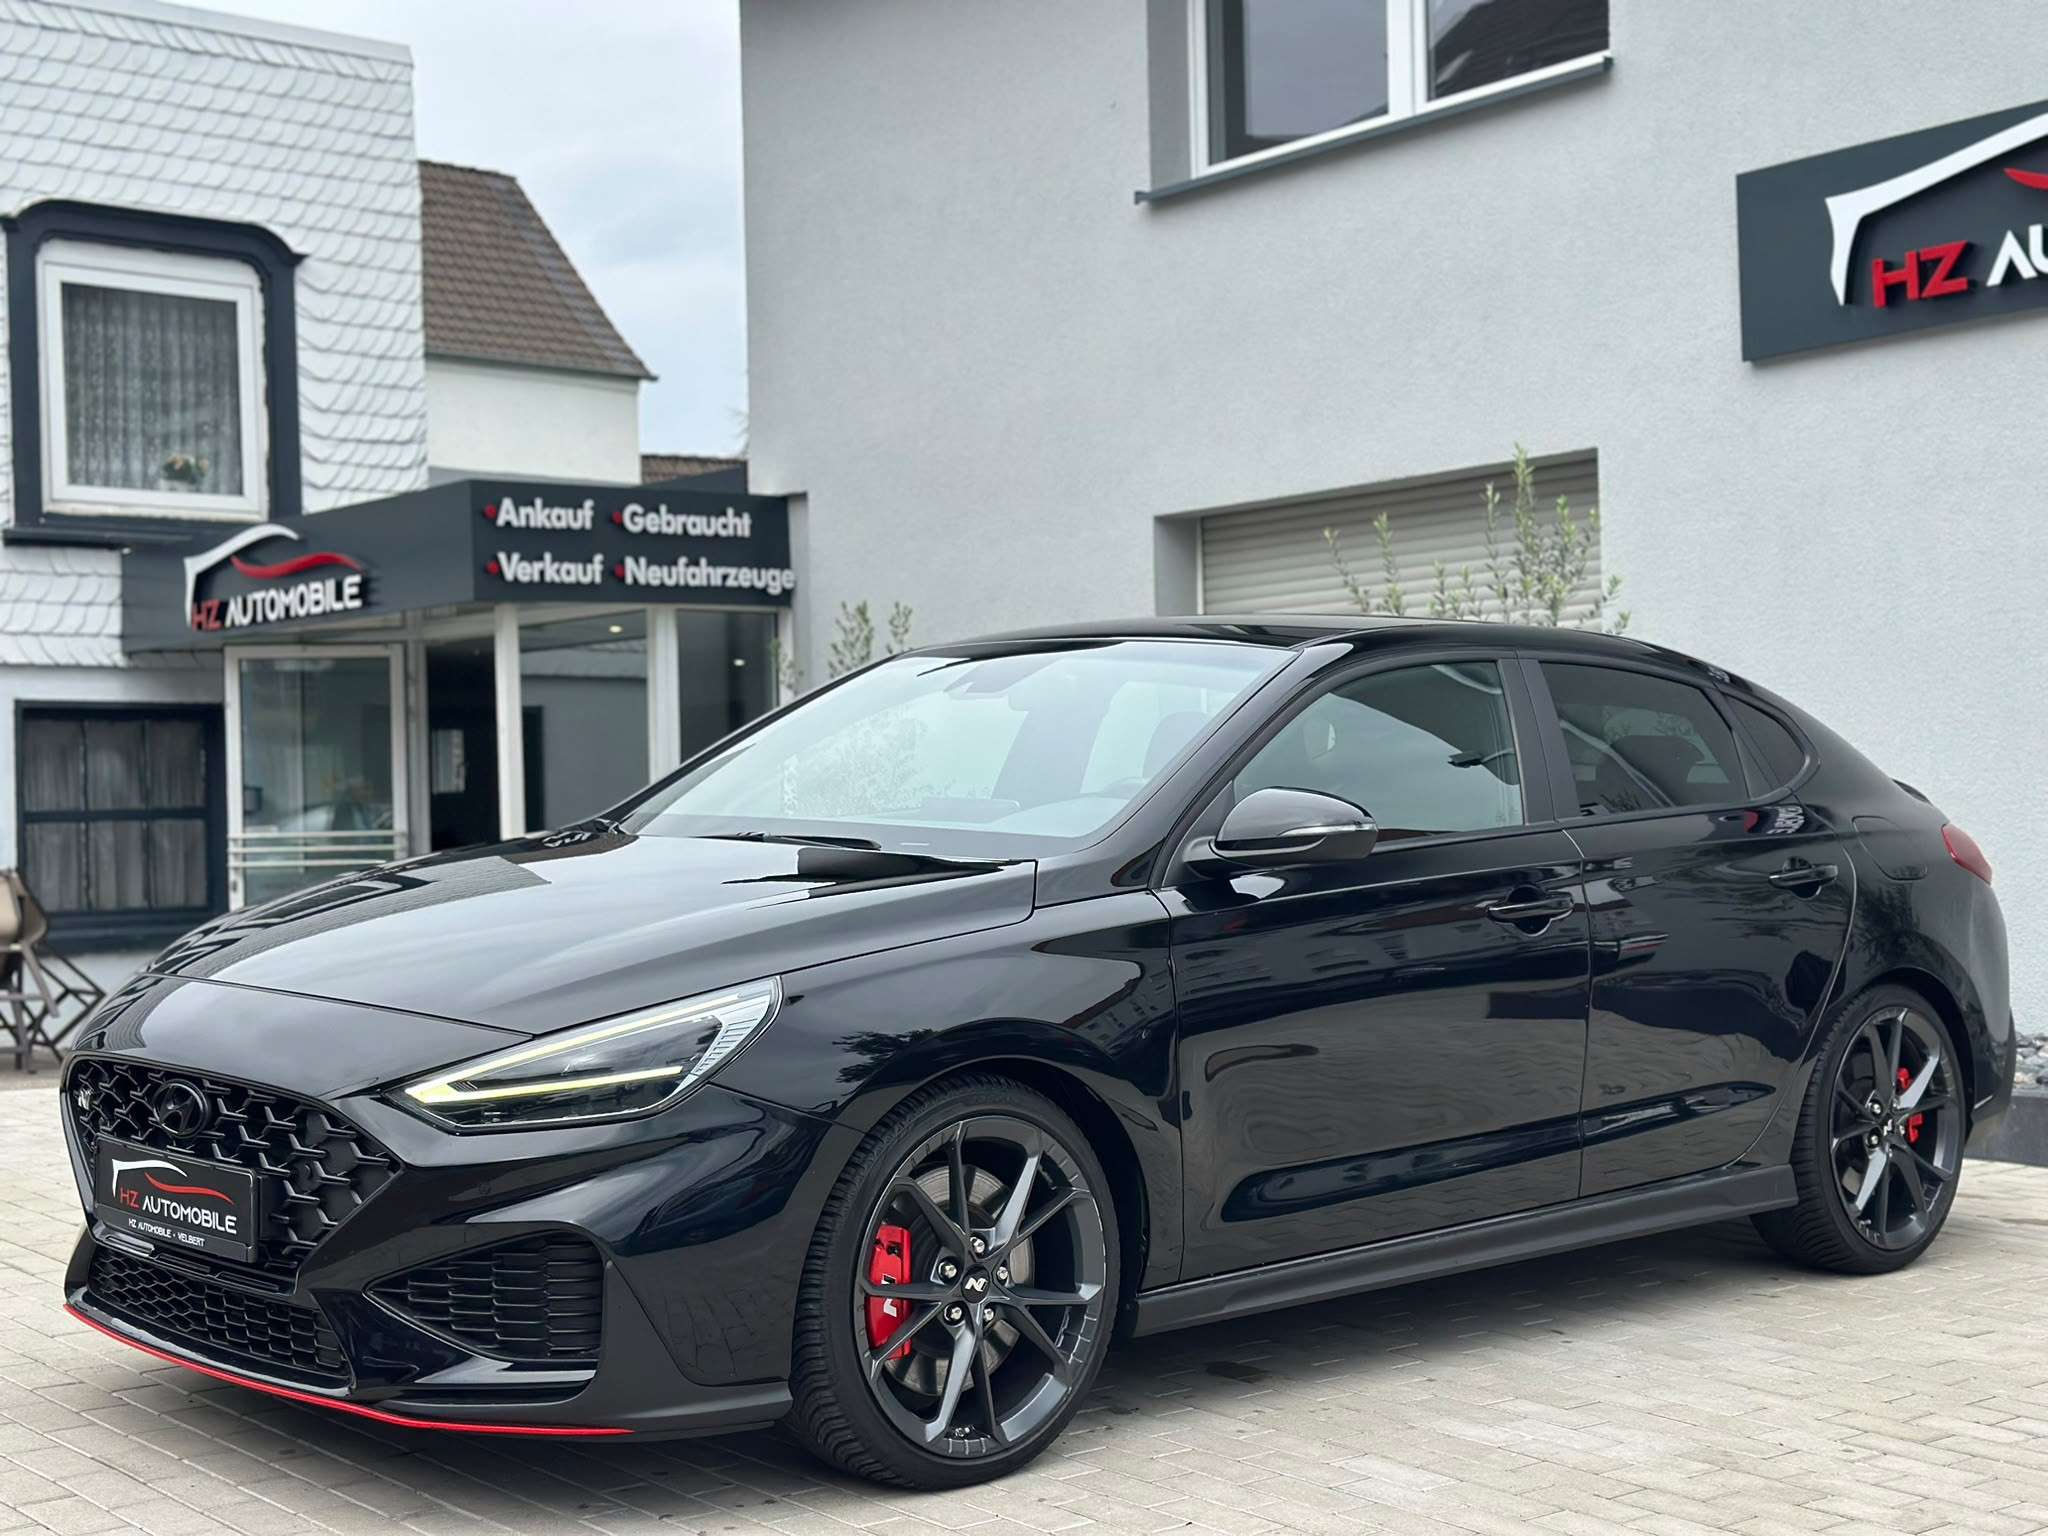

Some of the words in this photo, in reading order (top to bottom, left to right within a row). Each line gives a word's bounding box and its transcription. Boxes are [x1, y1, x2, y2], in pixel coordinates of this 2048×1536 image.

[1871, 240, 1969, 308] HZ
[496, 497, 595, 530] Ankauf
[622, 503, 752, 538] Gebraucht
[498, 552, 604, 585] Verkauf
[624, 556, 796, 595] Neufahrzeuge
[191, 599, 223, 632] HZ
[225, 573, 363, 628] AUTOMOBILE
[120, 1187, 140, 1209] HZ
[142, 1195, 237, 1235] AUTOMOBILE
[128, 1218, 137, 1228] HZ
[138, 1222, 172, 1239] AUTOMOBILE
[177, 1232, 205, 1247] VELBERT
